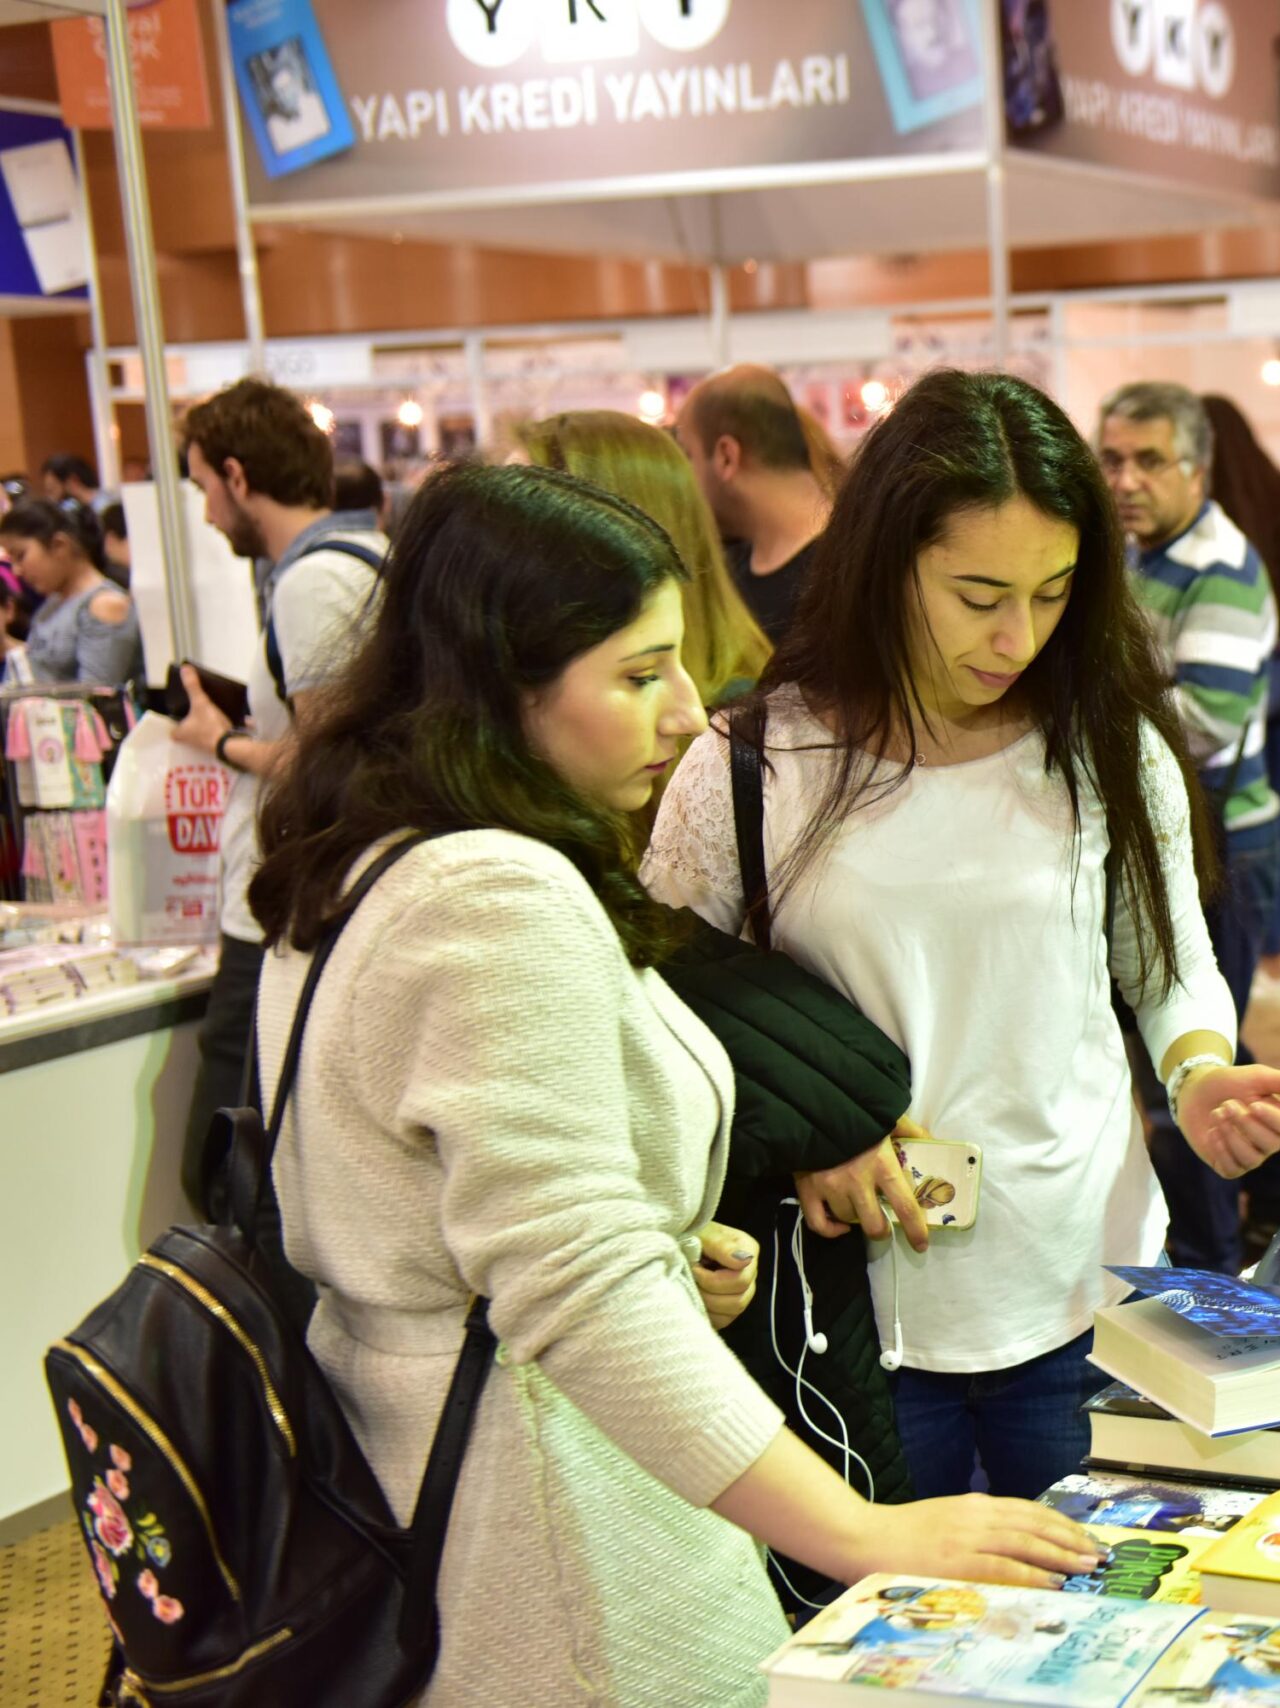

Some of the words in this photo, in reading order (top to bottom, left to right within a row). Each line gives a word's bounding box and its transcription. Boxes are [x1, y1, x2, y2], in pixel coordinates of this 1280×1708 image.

[352, 88, 449, 143] YAPI
[458, 66, 598, 134] KREDİ
[604, 53, 850, 122] YAYINLARI
